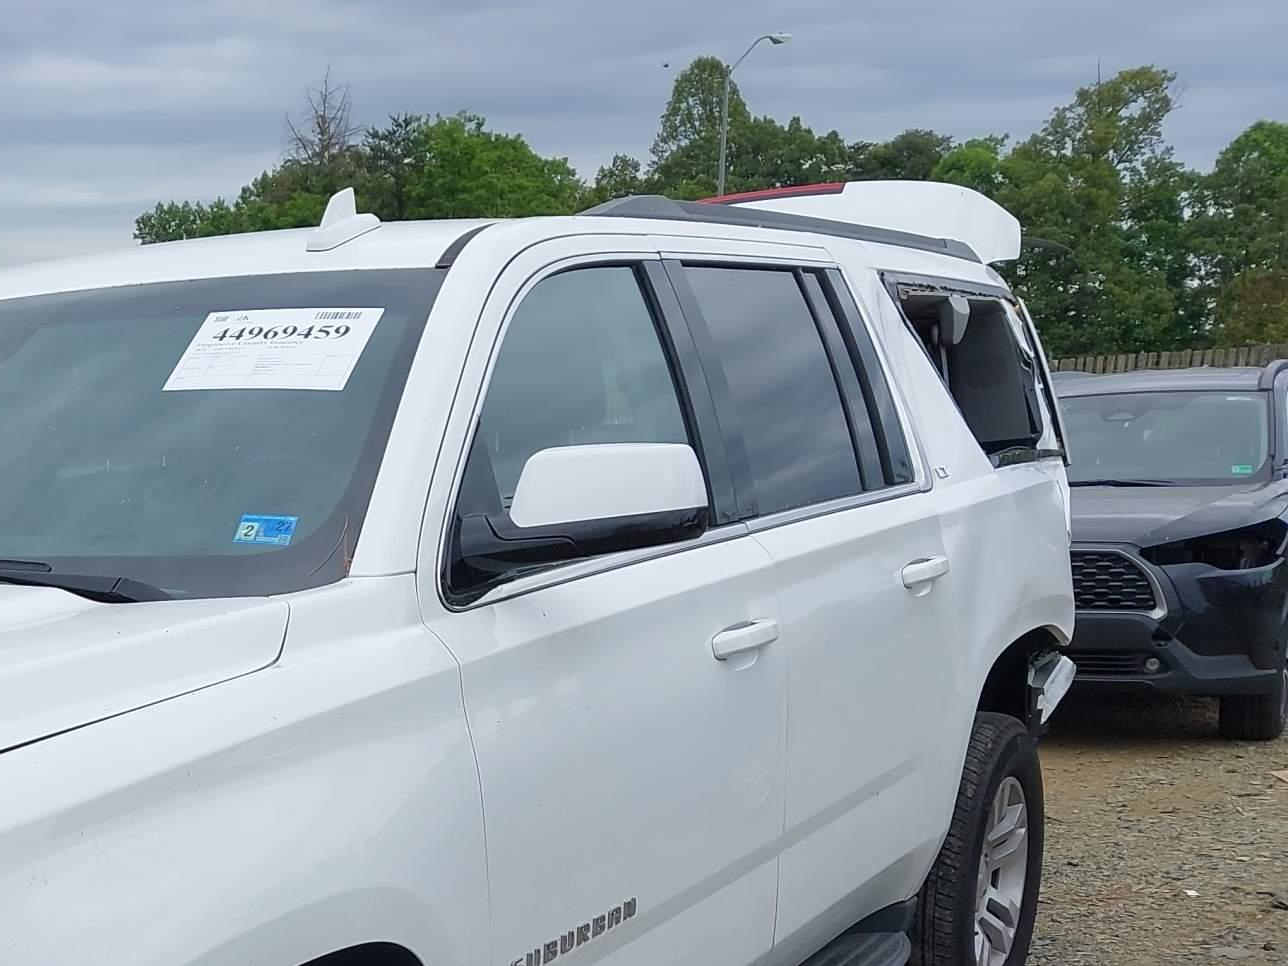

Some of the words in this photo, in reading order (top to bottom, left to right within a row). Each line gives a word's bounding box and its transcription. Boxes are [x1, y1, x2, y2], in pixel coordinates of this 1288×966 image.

[212, 325, 351, 342] 44969459
[243, 524, 255, 537] 2
[275, 520, 293, 532] 27
